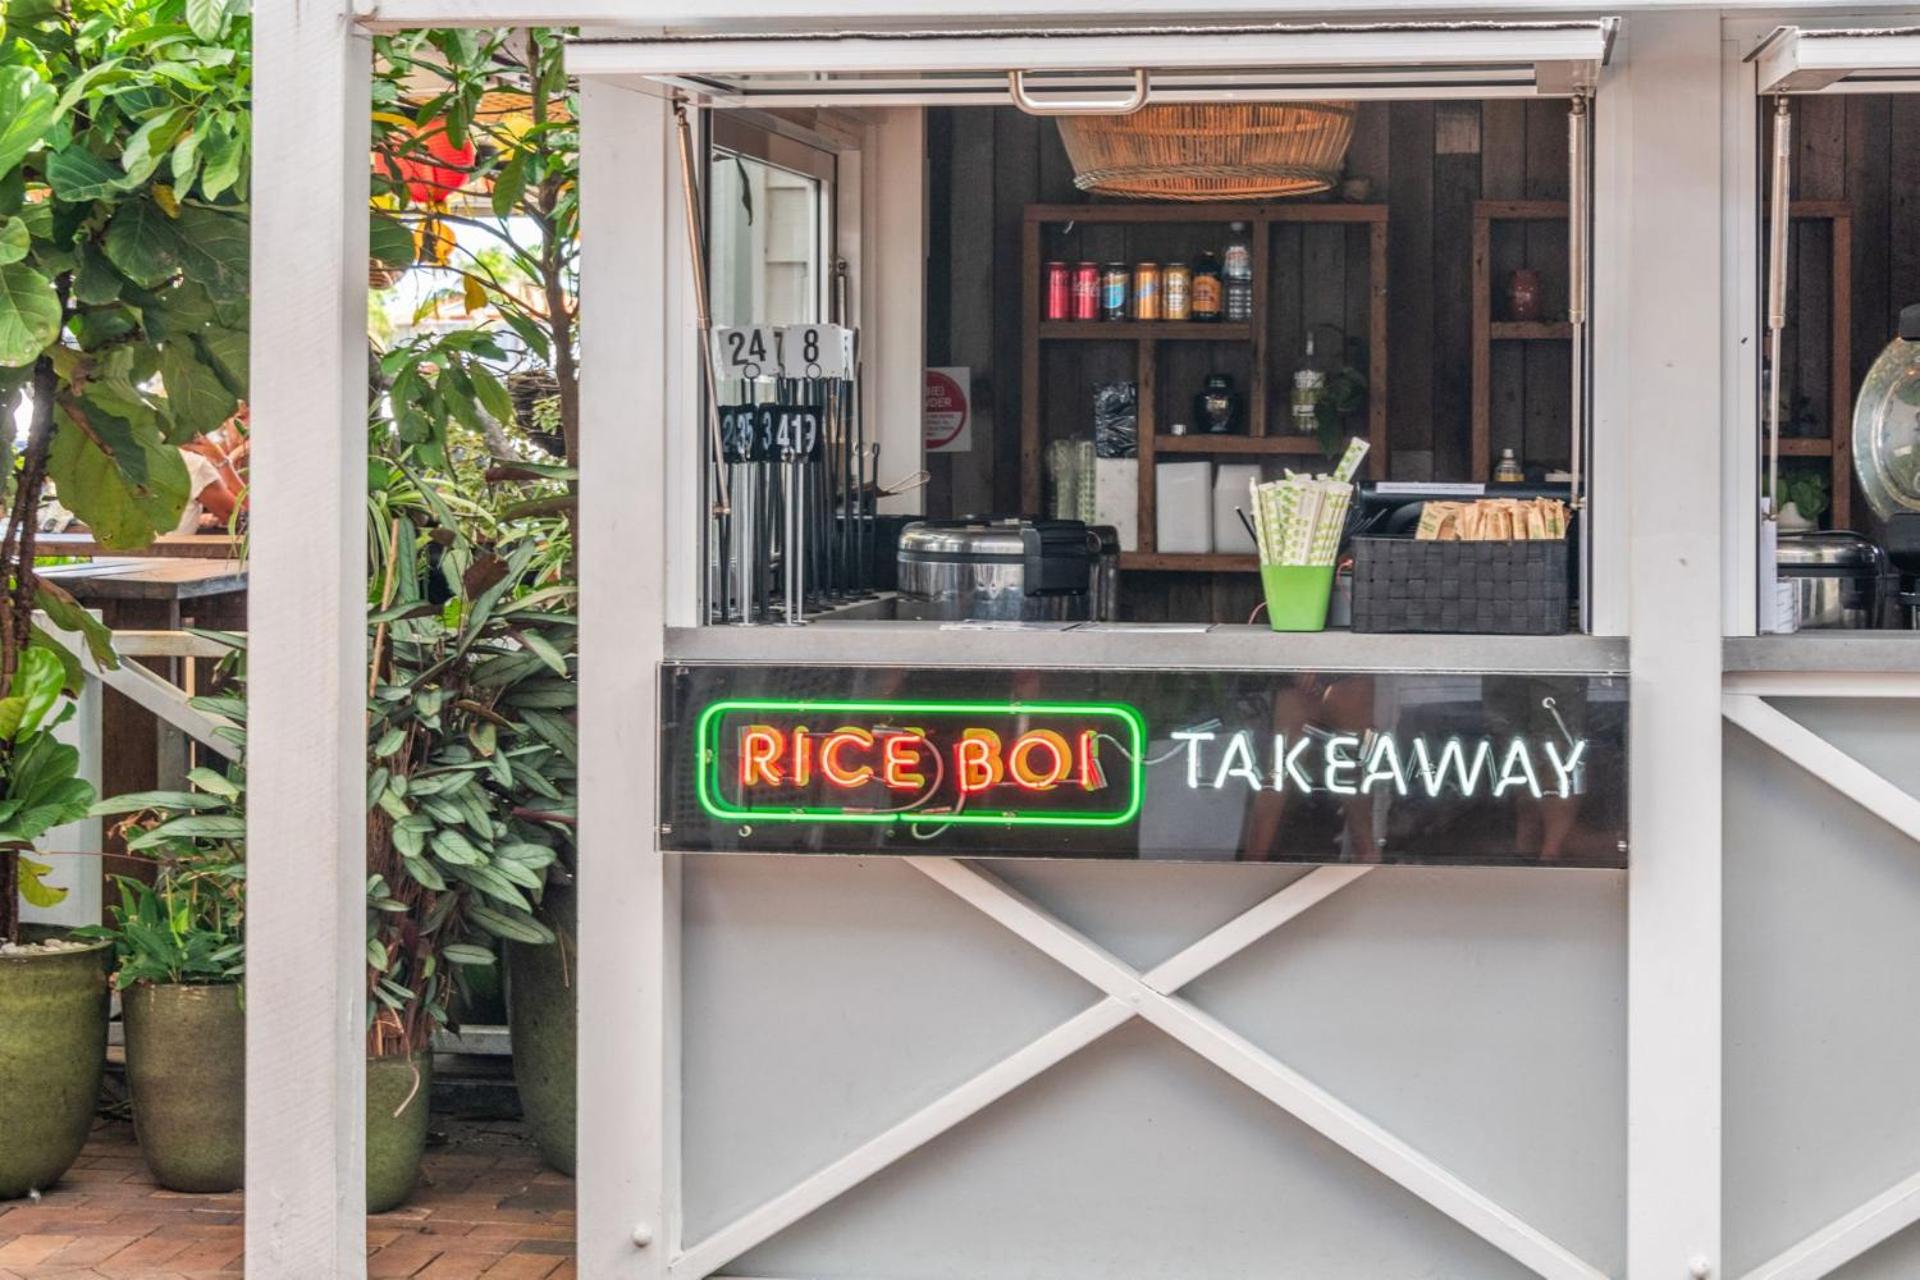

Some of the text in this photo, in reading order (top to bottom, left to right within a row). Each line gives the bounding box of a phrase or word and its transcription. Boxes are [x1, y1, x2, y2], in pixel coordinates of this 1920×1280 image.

[728, 329, 767, 366] 24
[803, 329, 819, 363] 8
[742, 726, 1587, 799] RICE BOI TAKEAWAY
